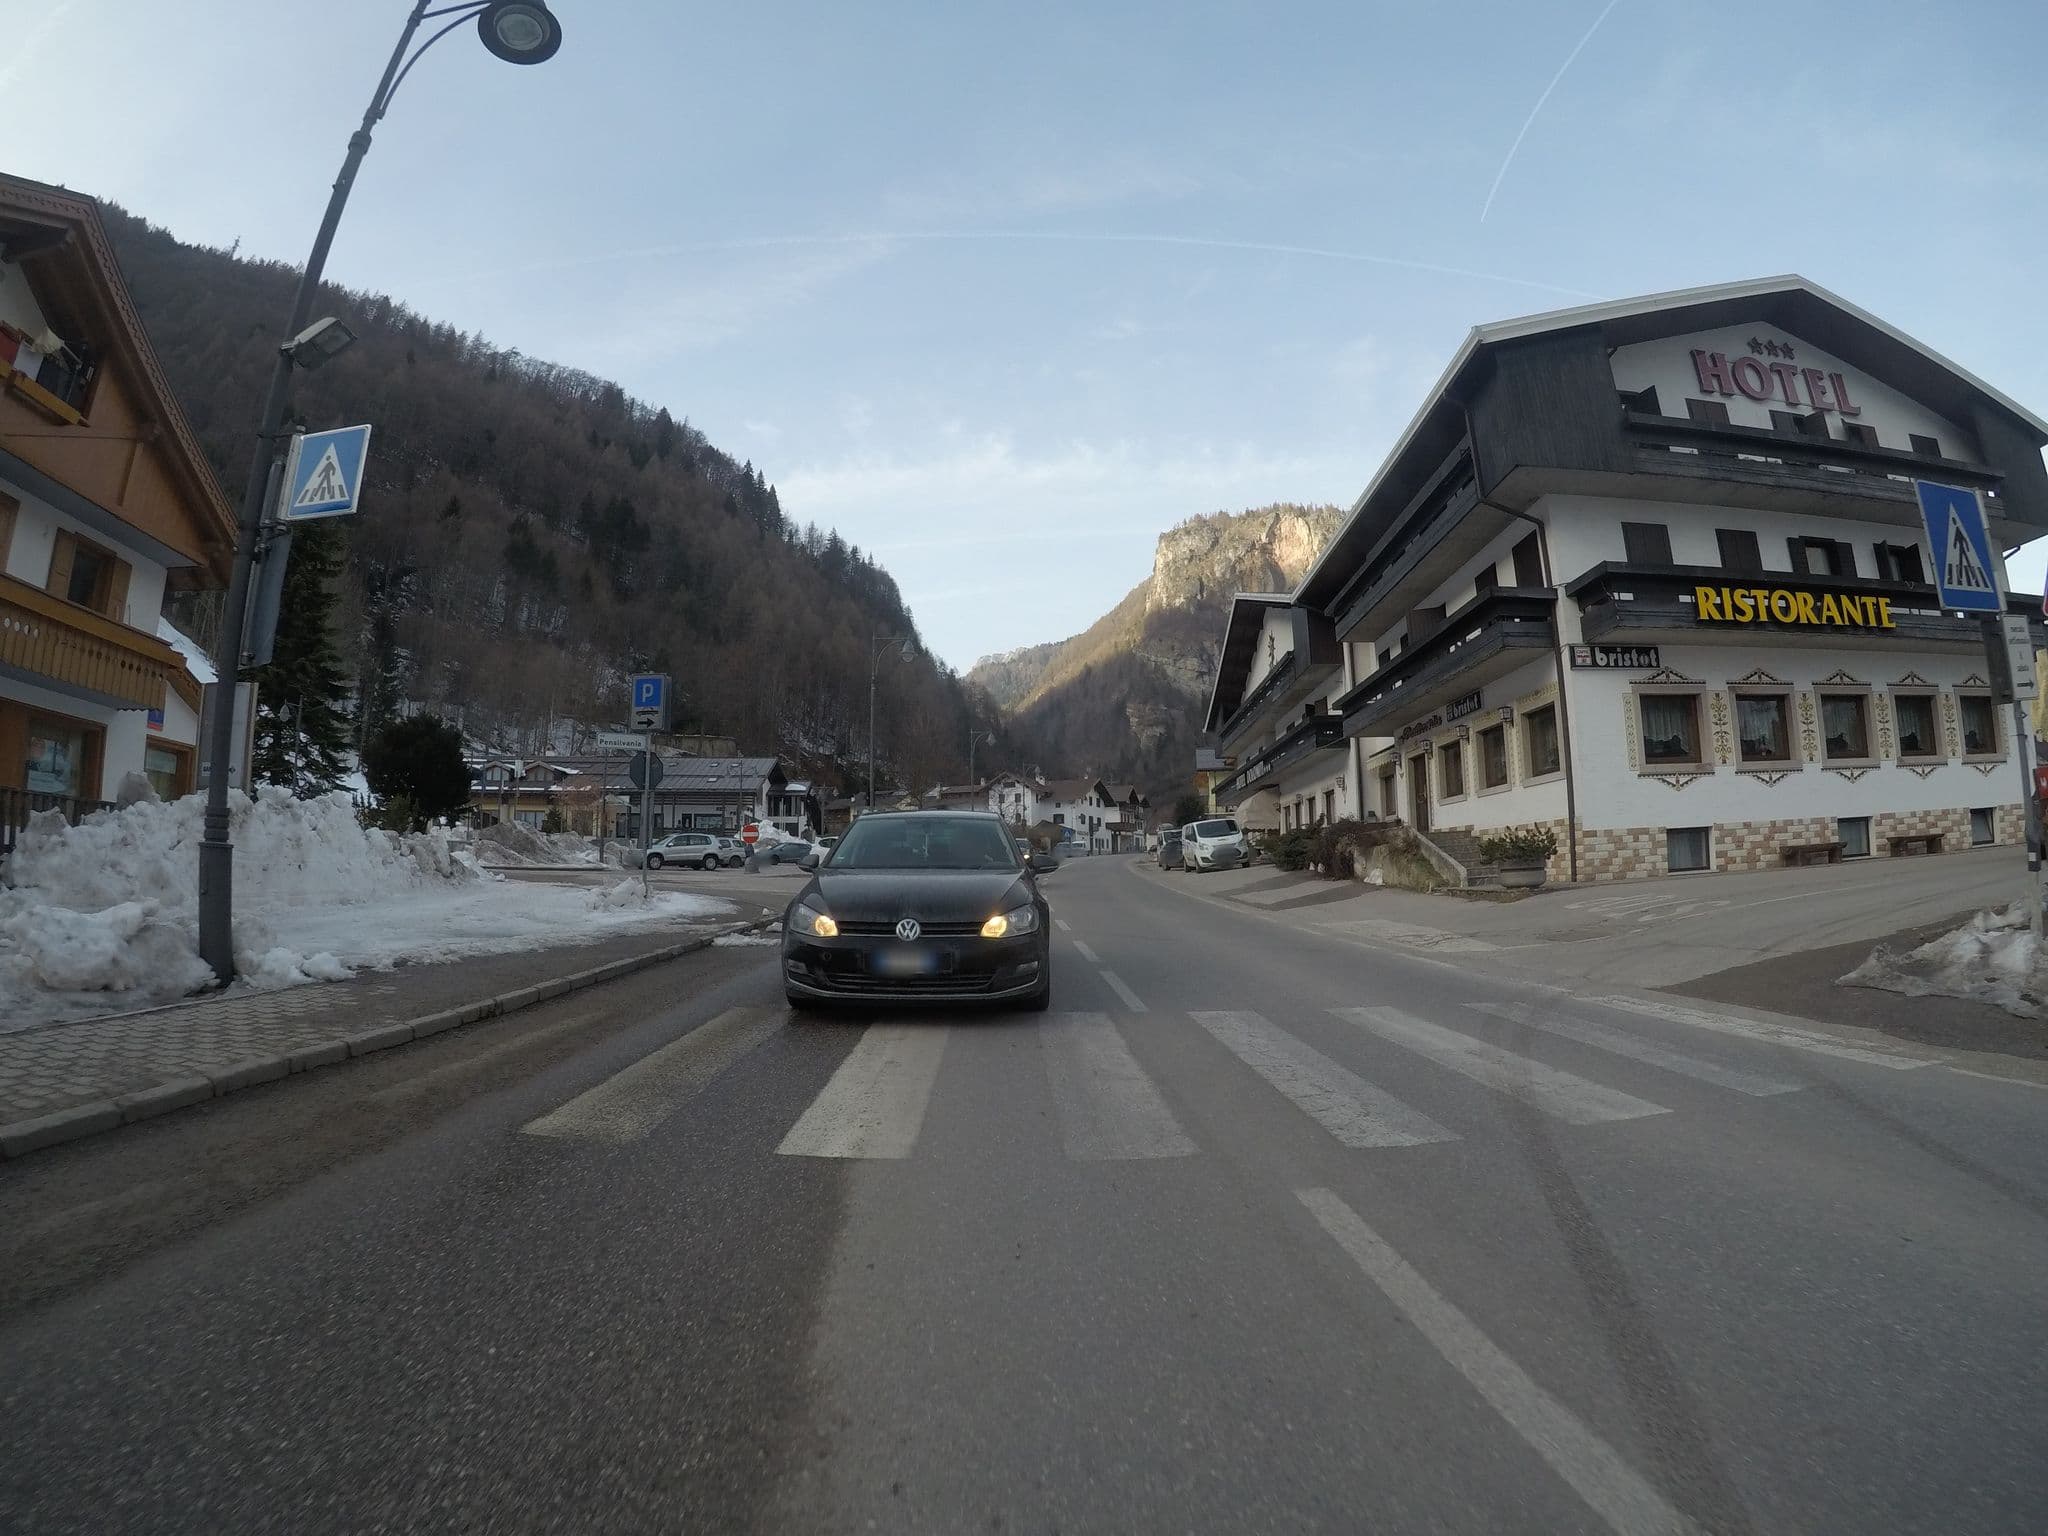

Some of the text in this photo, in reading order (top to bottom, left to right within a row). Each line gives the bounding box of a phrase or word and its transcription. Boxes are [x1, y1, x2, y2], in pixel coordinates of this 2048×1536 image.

[1690, 349, 1861, 416] HOTEL
[1695, 586, 1897, 628] RISTORANTE
[642, 683, 654, 702] P
